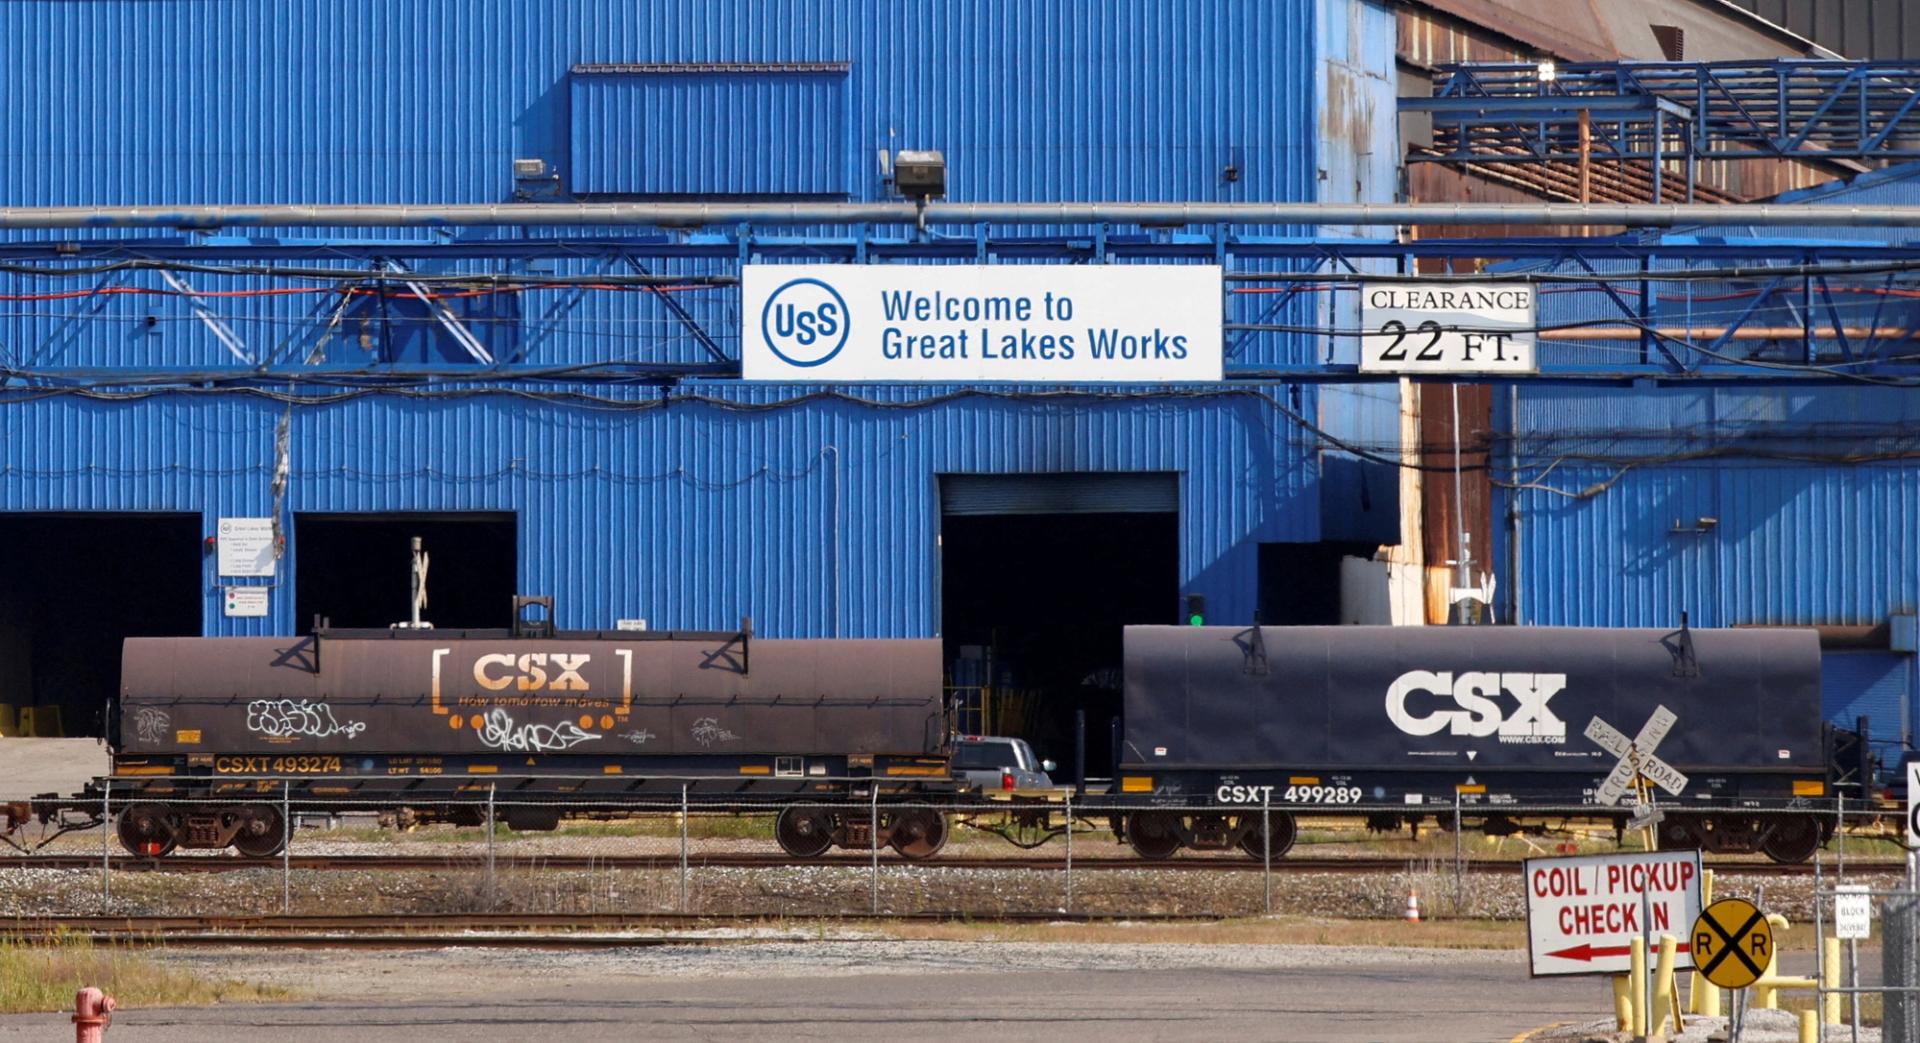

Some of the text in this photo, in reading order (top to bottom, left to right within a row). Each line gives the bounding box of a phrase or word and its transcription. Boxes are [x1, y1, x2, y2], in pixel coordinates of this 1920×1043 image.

[882, 291, 1073, 321] Welcome to
[1371, 290, 1530, 309] CLEARANCE
[776, 301, 839, 345] USS
[883, 328, 1188, 360] Great Lakes Works
[1379, 320, 1520, 361] 22 FT.
[473, 653, 590, 691] CSX
[459, 696, 610, 707] How tomorrow moves
[1385, 670, 1566, 737] CSX
[1498, 735, 1566, 744] WWW.CSX.COM
[216, 757, 342, 773] CSXT 493274
[1643, 759, 1682, 790] ROAD
[1217, 785, 1362, 803] CSXT 499289
[1533, 866, 1587, 898] COIL
[1607, 861, 1694, 894] PICKUP
[1558, 902, 1639, 935] CHECK
[1696, 932, 1768, 956] R R
